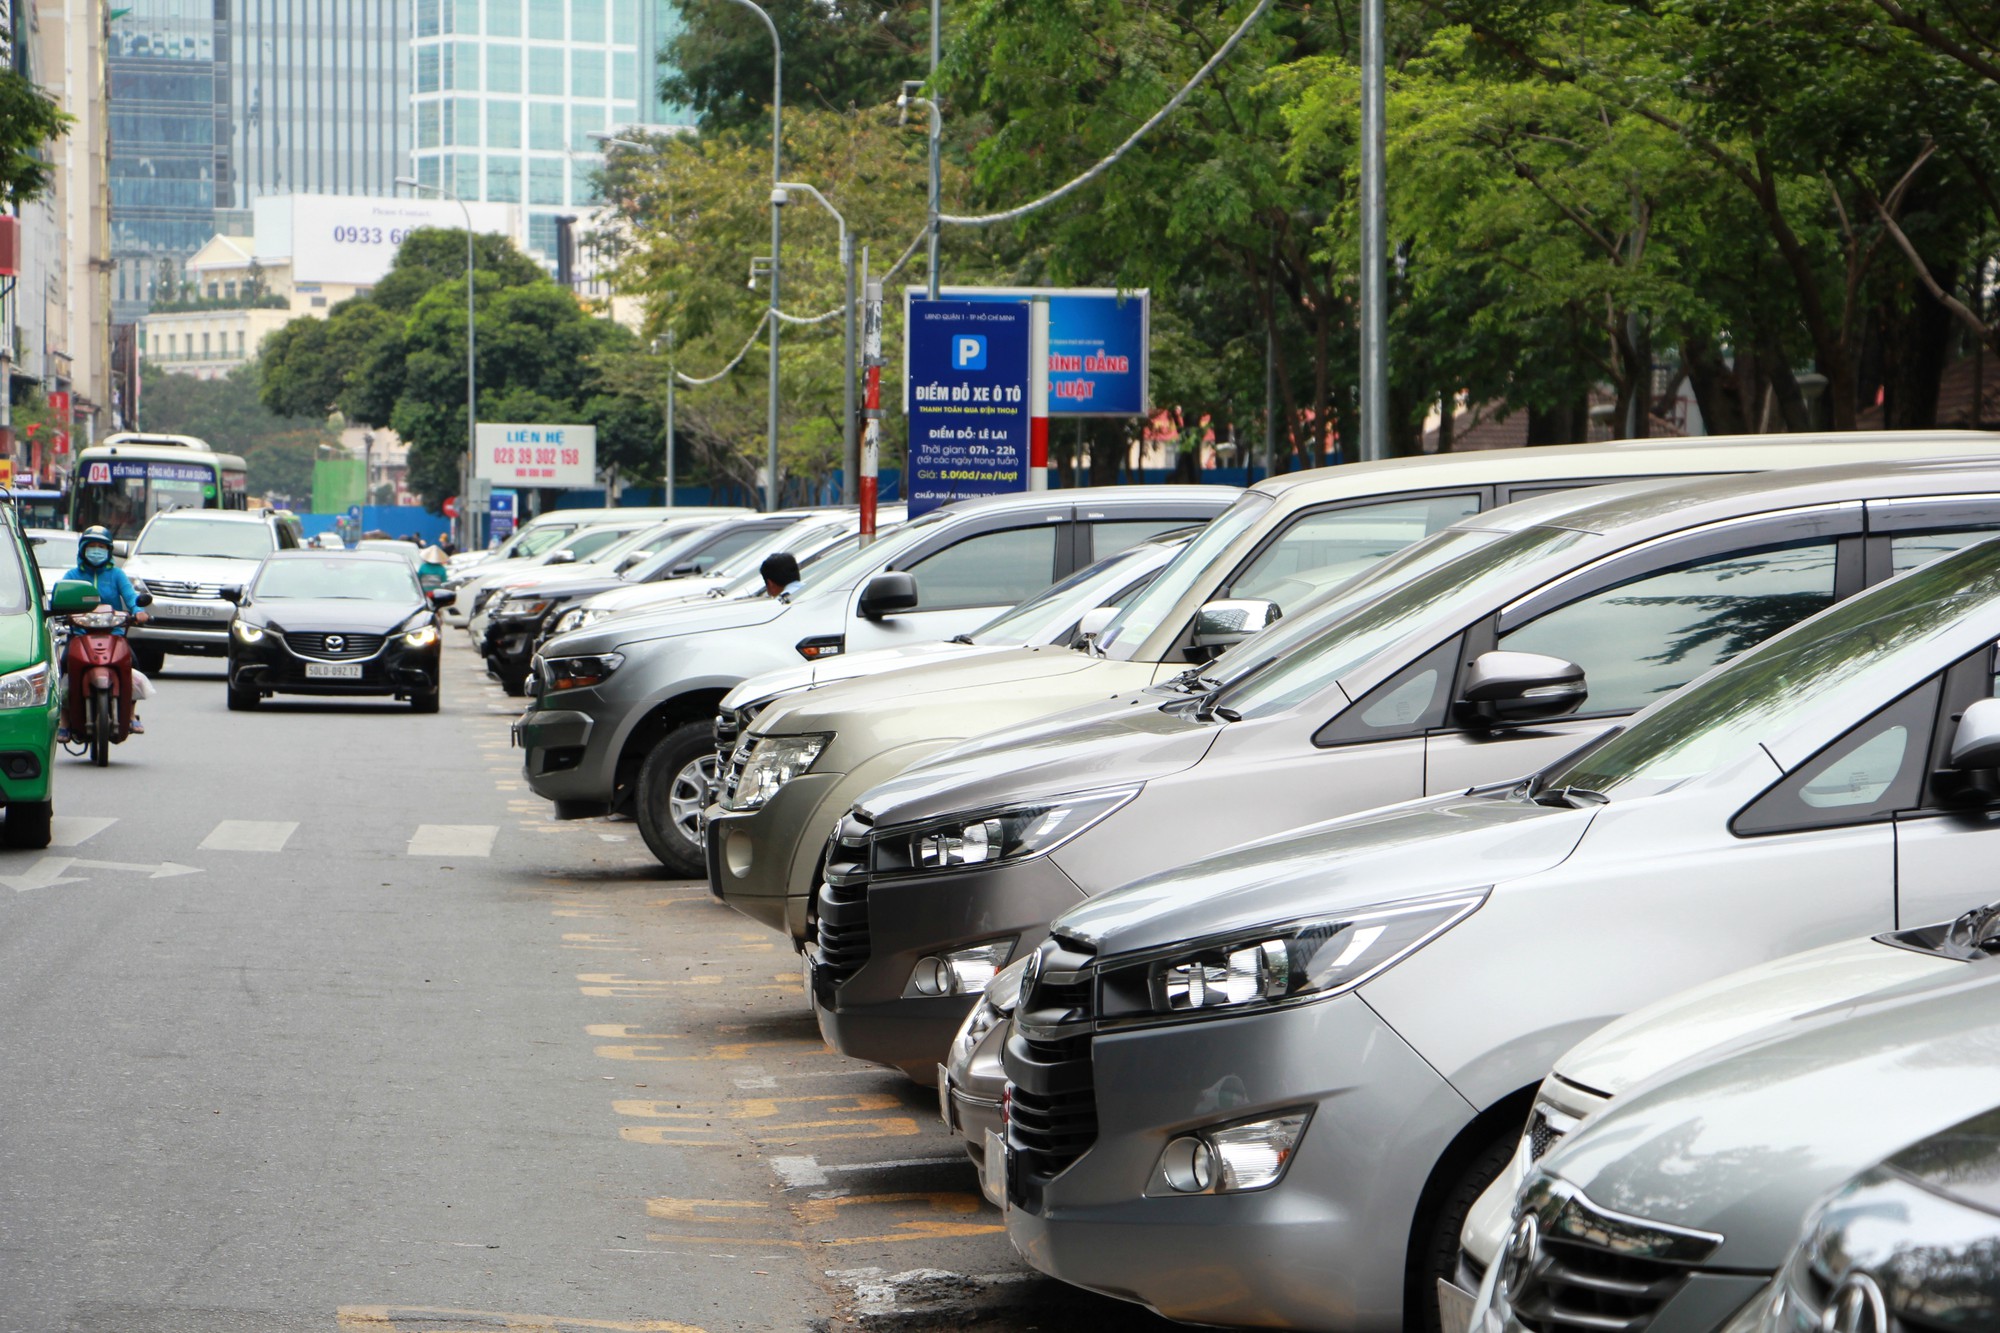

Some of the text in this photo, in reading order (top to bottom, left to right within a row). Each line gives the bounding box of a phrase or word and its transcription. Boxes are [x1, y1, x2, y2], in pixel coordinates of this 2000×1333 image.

[334, 225, 383, 245] 0933
[959, 338, 980, 366] P
[916, 380, 1022, 402] ĐIỂM ĐỖ XE Ô TÔ
[1056, 379, 1095, 402] LUẬT
[943, 405, 962, 414] TOÁN
[963, 406, 979, 414] QUA
[997, 407, 1018, 415] THOẠI
[929, 425, 1008, 440] ĐIỂM ĐỖ: LÊ LAI
[921, 444, 941, 454] Thời
[942, 446, 967, 456] gian:
[969, 446, 989, 455] 07h
[996, 446, 1016, 456] 22h
[916, 456, 1020, 467] (tất các ngày trong tuần)
[92, 464, 109, 482] 04
[917, 470, 938, 479] Giá:
[914, 490, 935, 499] CHẤP
